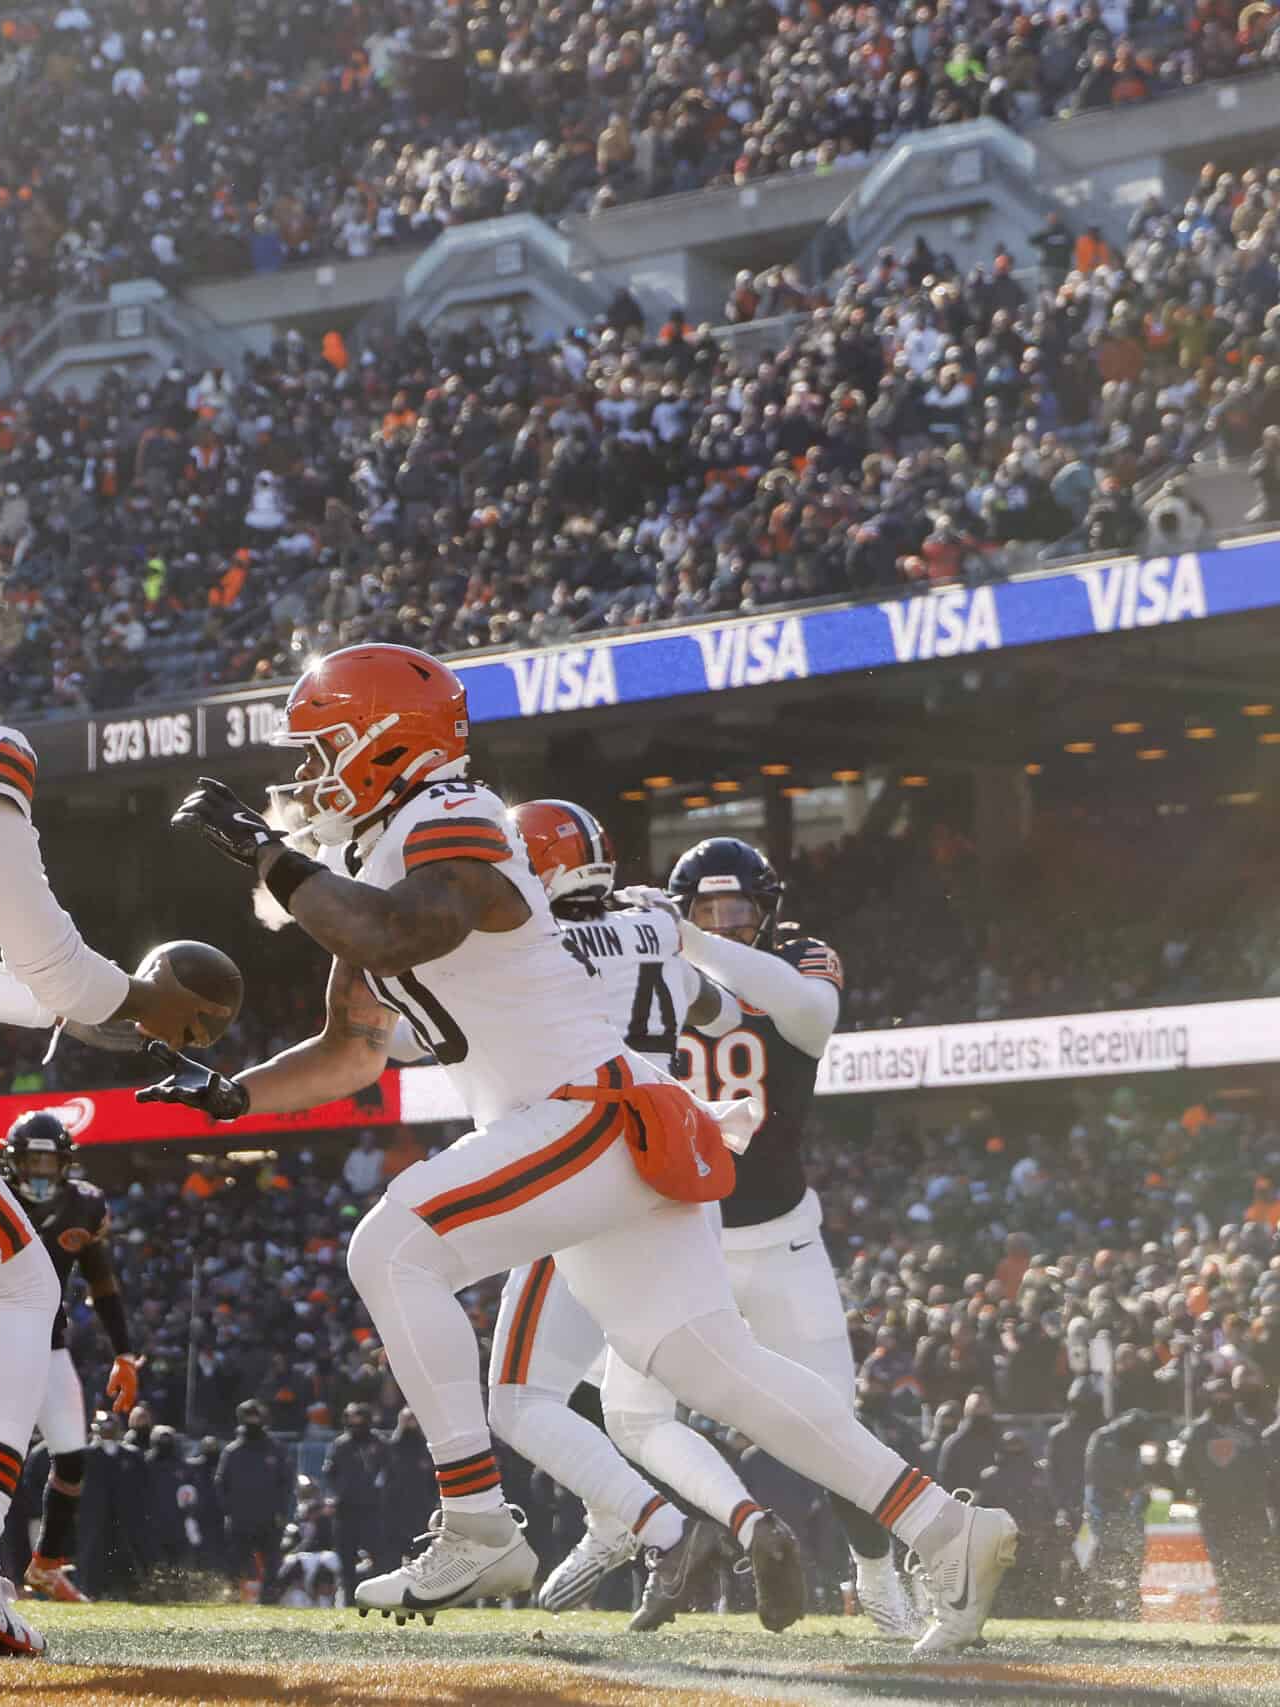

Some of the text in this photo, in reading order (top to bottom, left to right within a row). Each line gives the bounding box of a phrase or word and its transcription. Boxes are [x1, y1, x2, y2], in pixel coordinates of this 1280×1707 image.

[880, 584, 1002, 662] VISA
[1075, 552, 1207, 632] VISA
[505, 646, 618, 716] VISA
[692, 618, 809, 690] VISA
[102, 713, 191, 764] 373 YDS
[226, 706, 245, 747] 3
[634, 924, 660, 955] JR
[828, 1015, 1188, 1086] Fantasy Leaders: Receiving
